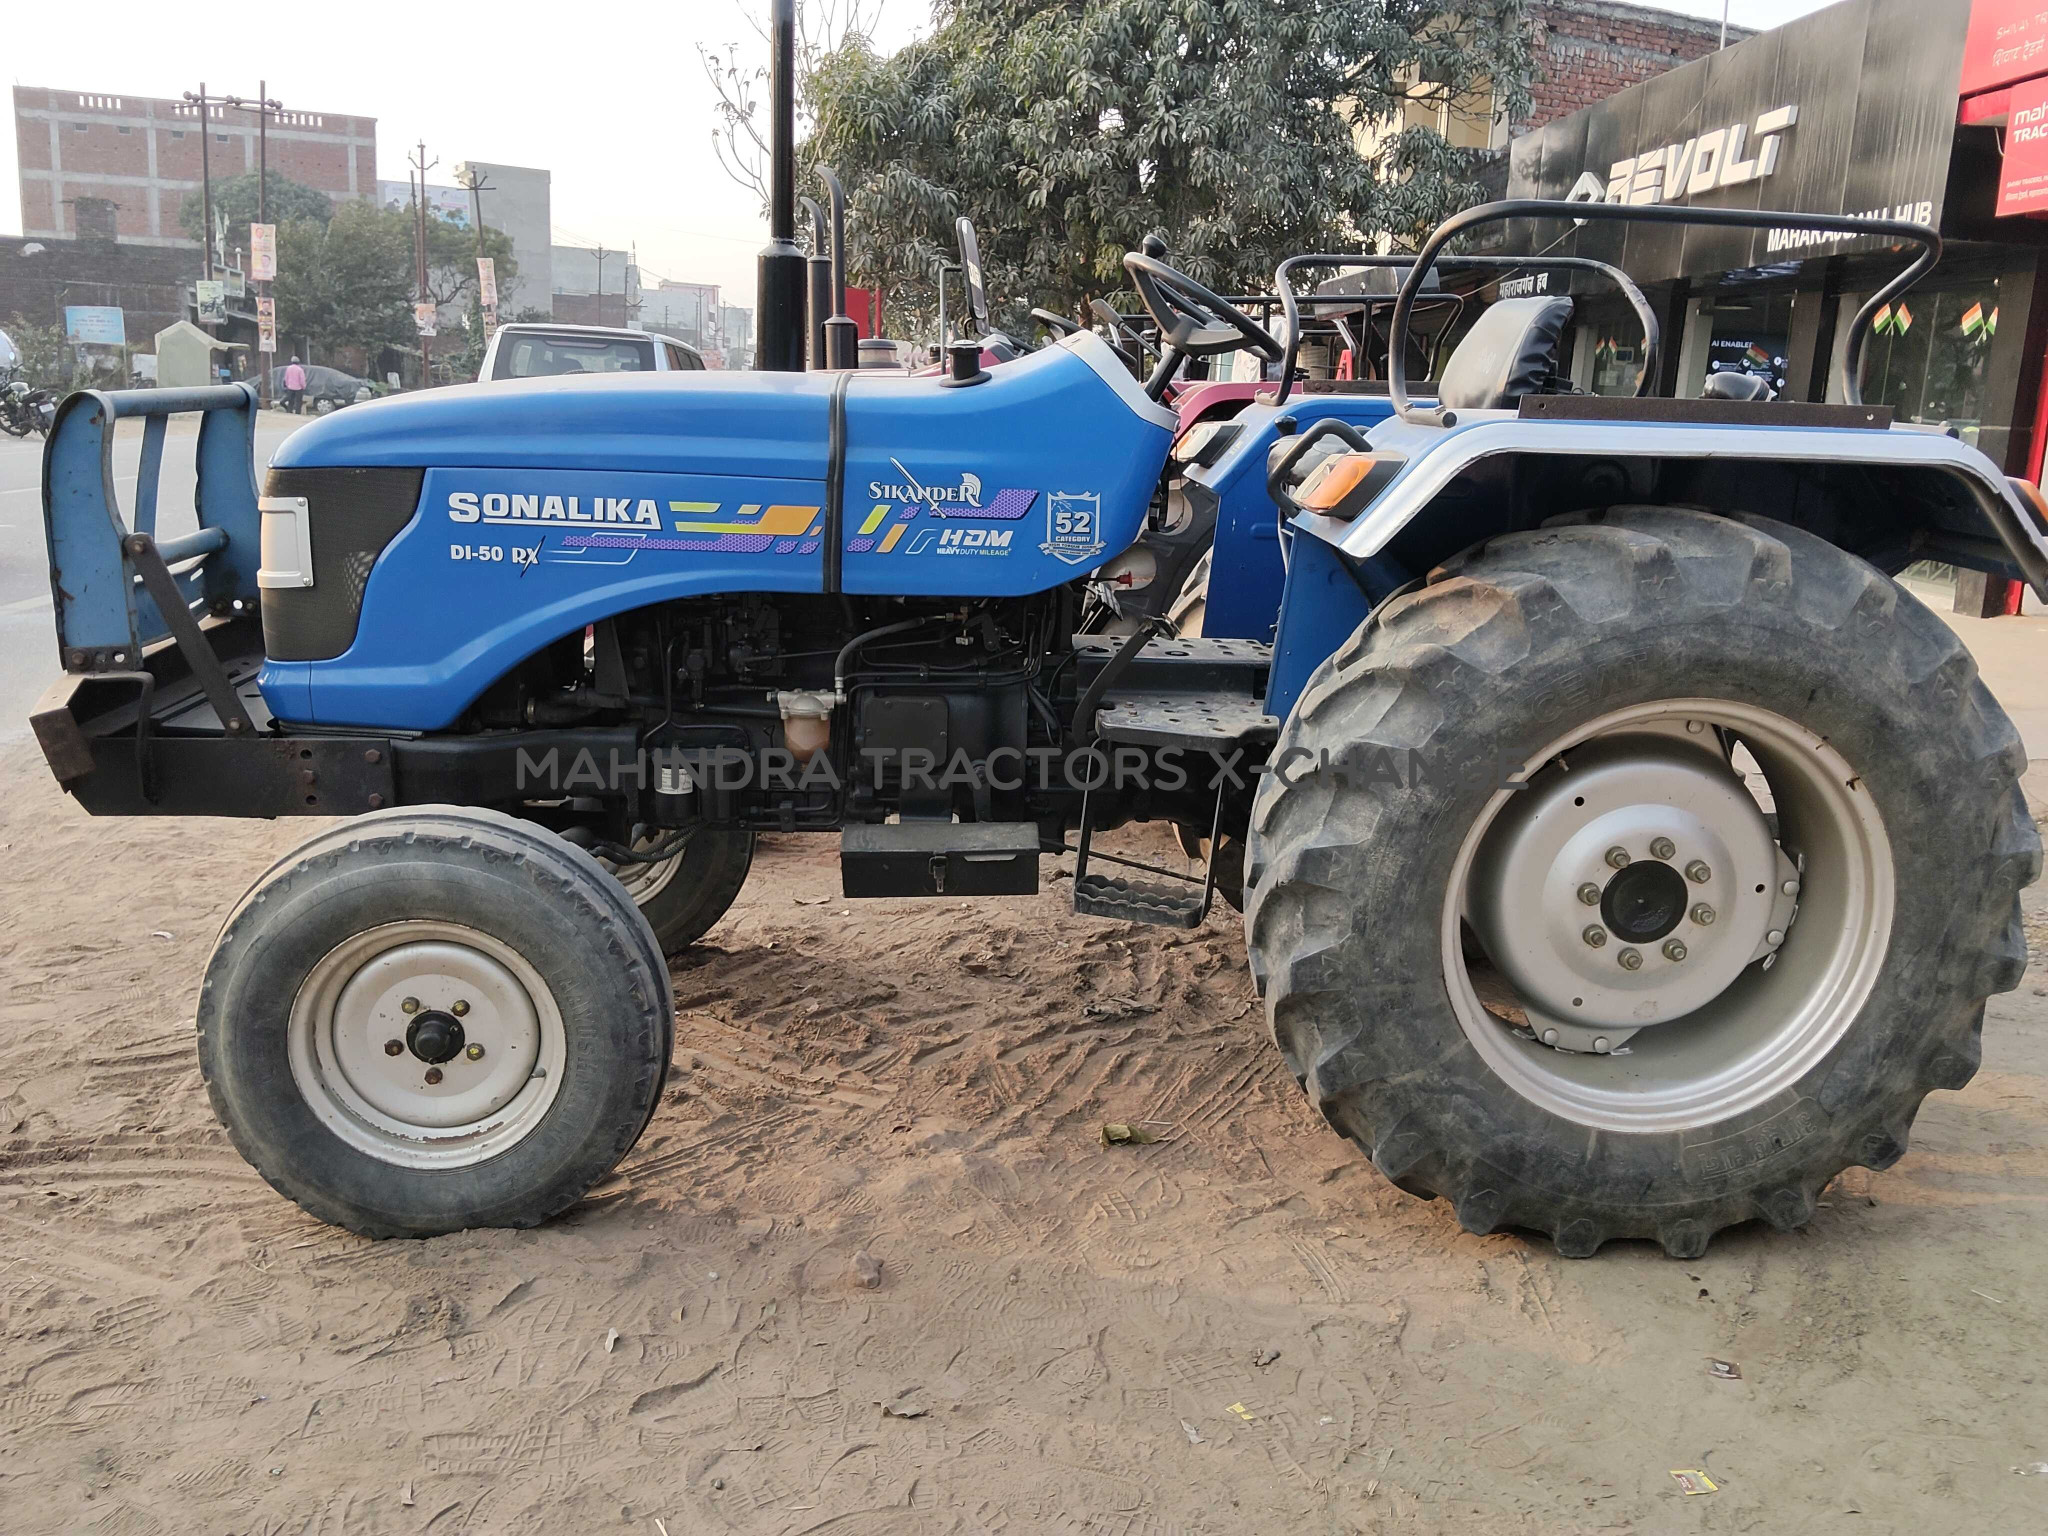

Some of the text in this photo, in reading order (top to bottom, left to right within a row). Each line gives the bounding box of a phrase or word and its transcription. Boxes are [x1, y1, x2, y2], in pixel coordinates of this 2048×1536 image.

[1605, 105, 1798, 205] REVOLT
[1894, 201, 1932, 226] HUB
[868, 480, 982, 508] SIKANDER
[448, 492, 661, 530] SONALIKA
[1055, 512, 1091, 534] 52
[939, 529, 1014, 547] HDM
[450, 544, 540, 566] DI-50 RX
